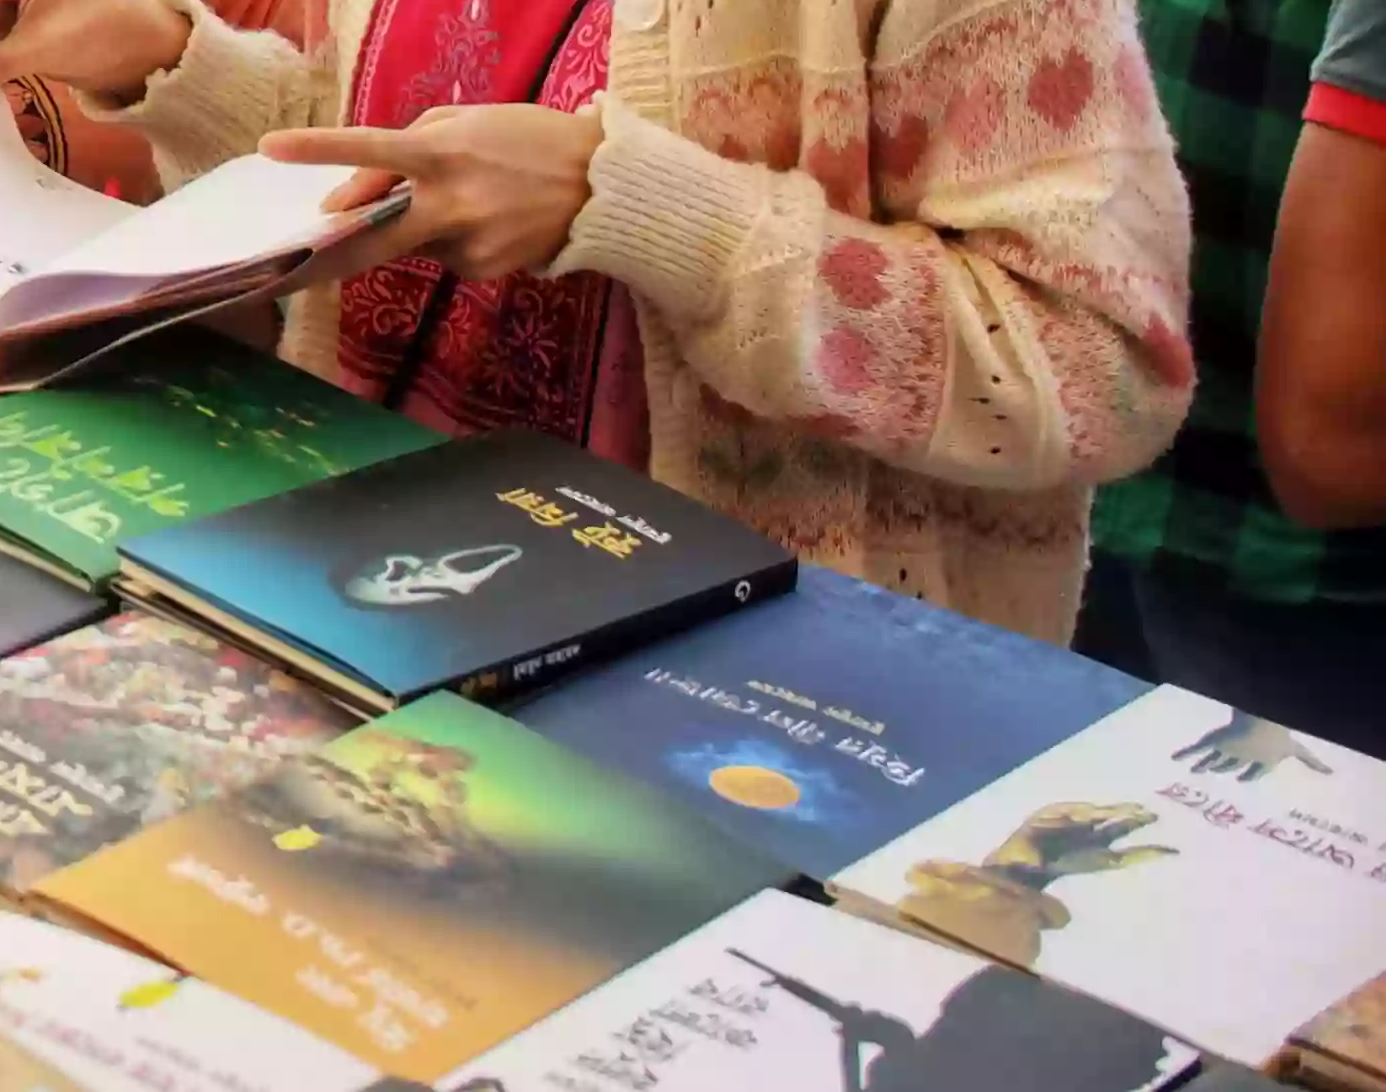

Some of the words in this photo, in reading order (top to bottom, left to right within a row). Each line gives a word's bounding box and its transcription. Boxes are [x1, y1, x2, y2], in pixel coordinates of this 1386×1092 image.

[835, 737, 926, 787] হিমুর
[1154, 781, 1245, 829] ধীরে
[1245, 816, 1356, 869] আসে
